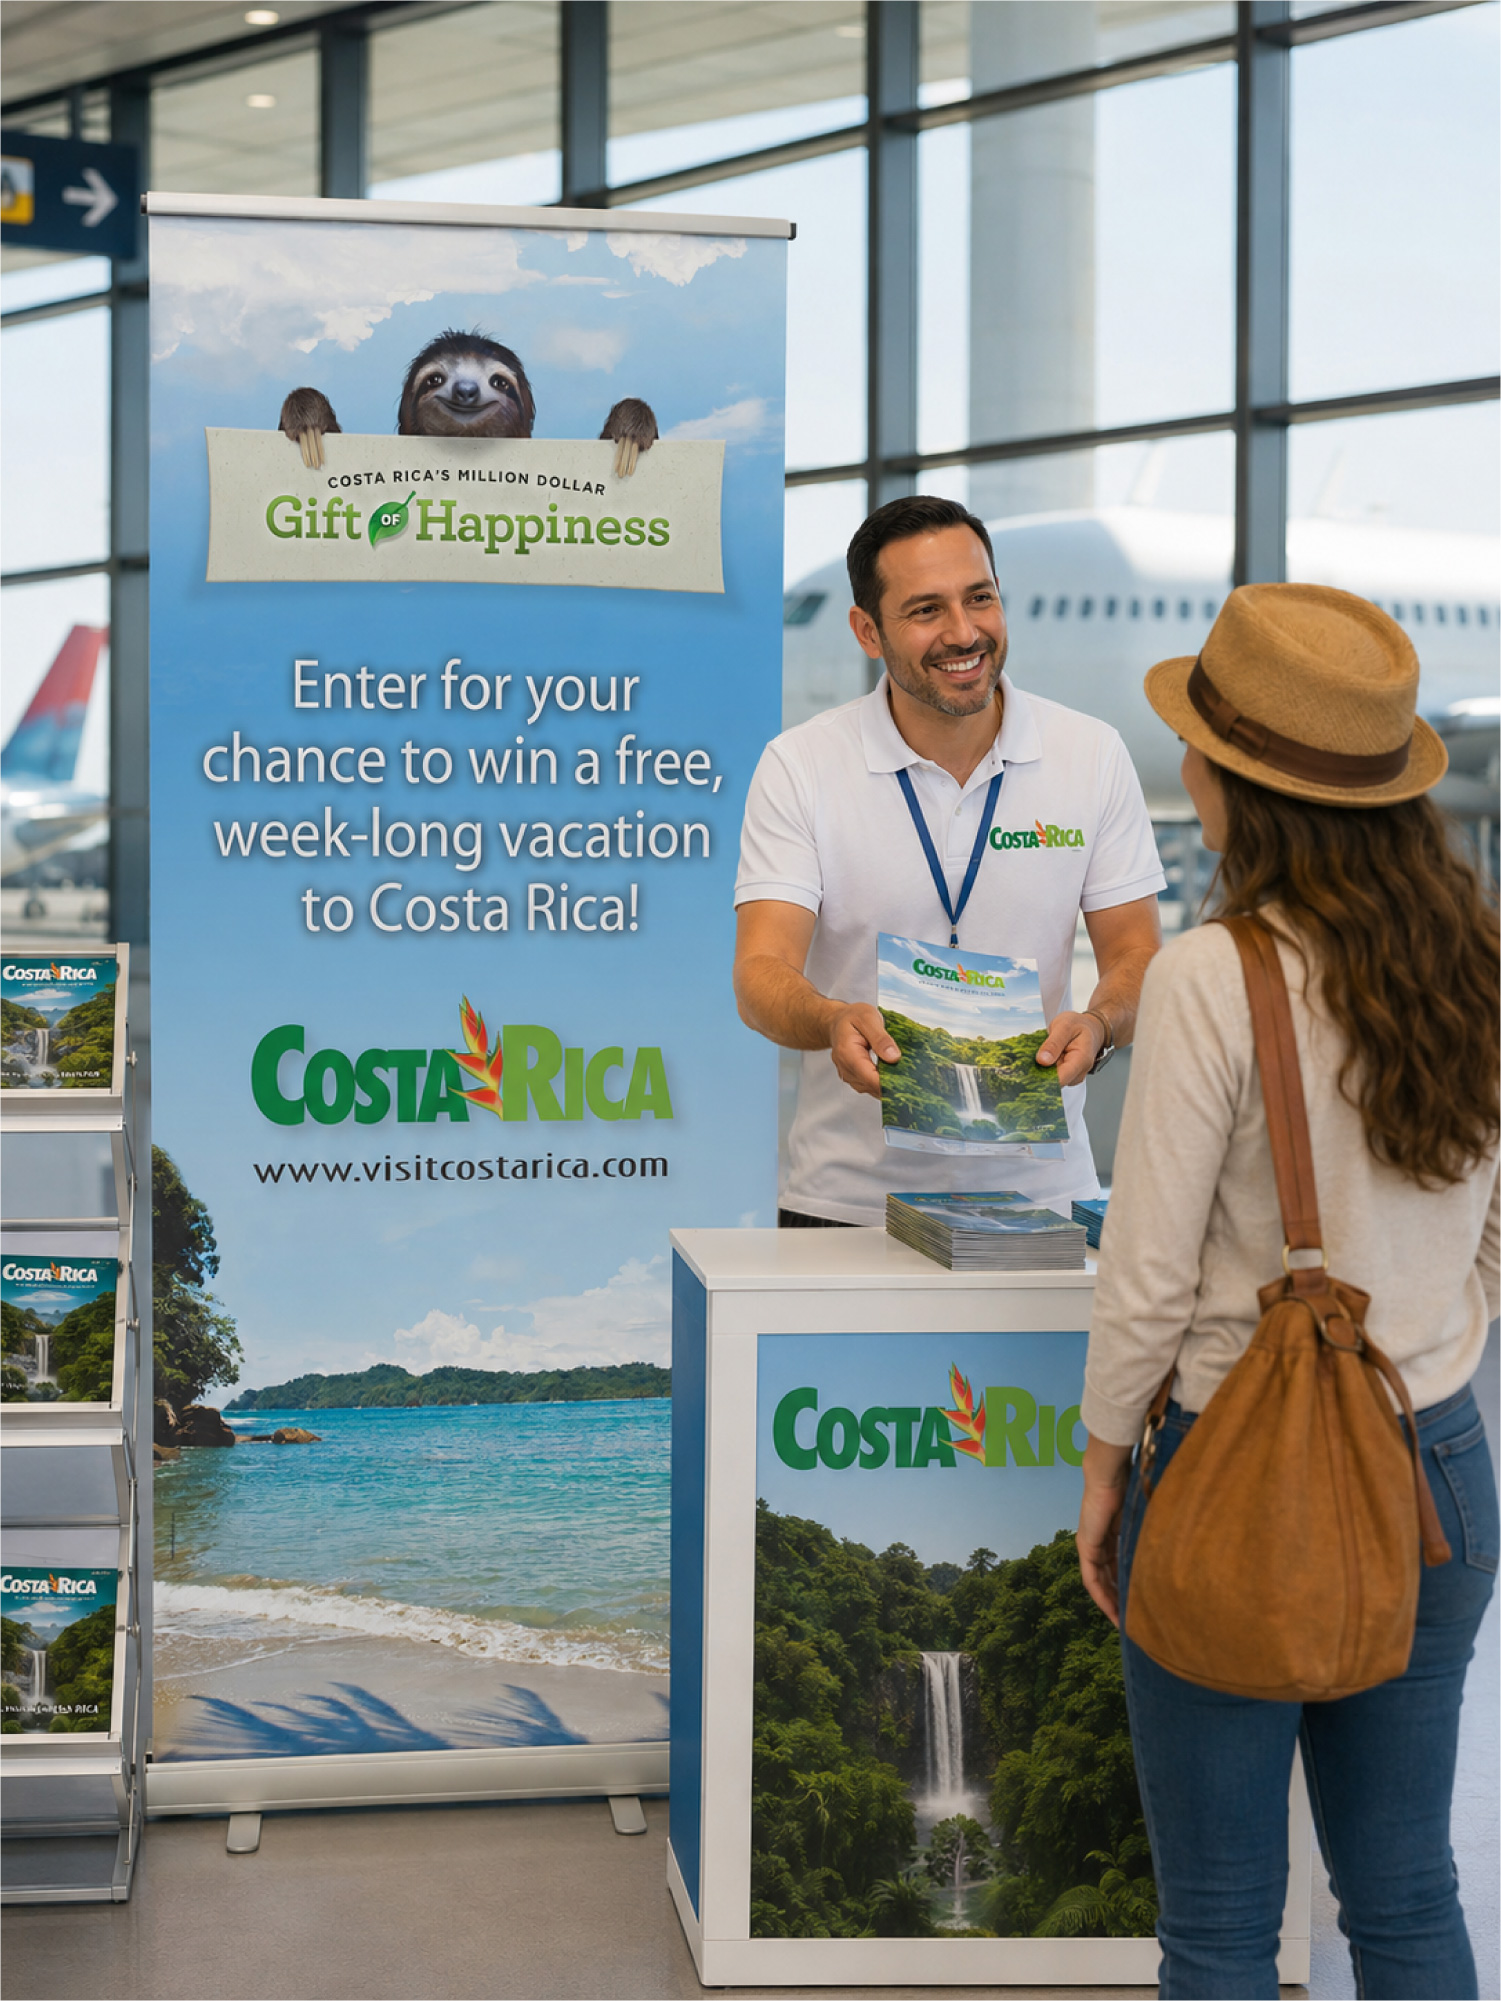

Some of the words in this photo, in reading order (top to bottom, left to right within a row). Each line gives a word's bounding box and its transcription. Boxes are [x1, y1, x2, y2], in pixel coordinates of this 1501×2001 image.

[328, 472, 385, 489] COSTA
[393, 469, 450, 482] RICA'S
[458, 470, 529, 484] MILLION
[537, 476, 605, 496] DOLLAR
[266, 495, 361, 539] Gift
[381, 514, 400, 526] OF
[416, 499, 670, 554] Happiness
[295, 659, 426, 709] Enter
[441, 658, 511, 710] for
[525, 675, 640, 725] your
[203, 731, 386, 783] chance
[400, 741, 453, 784] to
[468, 736, 557, 785] win
[575, 748, 599, 785] a
[615, 734, 723, 793] free,
[214, 806, 482, 871] week-long
[499, 810, 711, 858] vacation
[989, 826, 1040, 850] COSTA
[1045, 825, 1085, 848] RICA
[303, 888, 354, 931] to
[370, 882, 509, 931] Costa
[527, 882, 639, 931] Rica!
[2, 965, 51, 981] COSTA
[60, 965, 97, 980] RICA
[912, 958, 960, 983] COSTA
[251, 1024, 470, 1126] COSTA
[502, 1024, 674, 1122] RICA
[253, 1152, 669, 1183] www.visitcostarica.com
[2, 1263, 52, 1281] COSTA
[60, 1266, 98, 1282] RICA
[773, 1386, 957, 1470] COSTA
[985, 1386, 1085, 1467] RIC
[1, 1575, 49, 1593] COSTA
[57, 1577, 97, 1594] RICA
